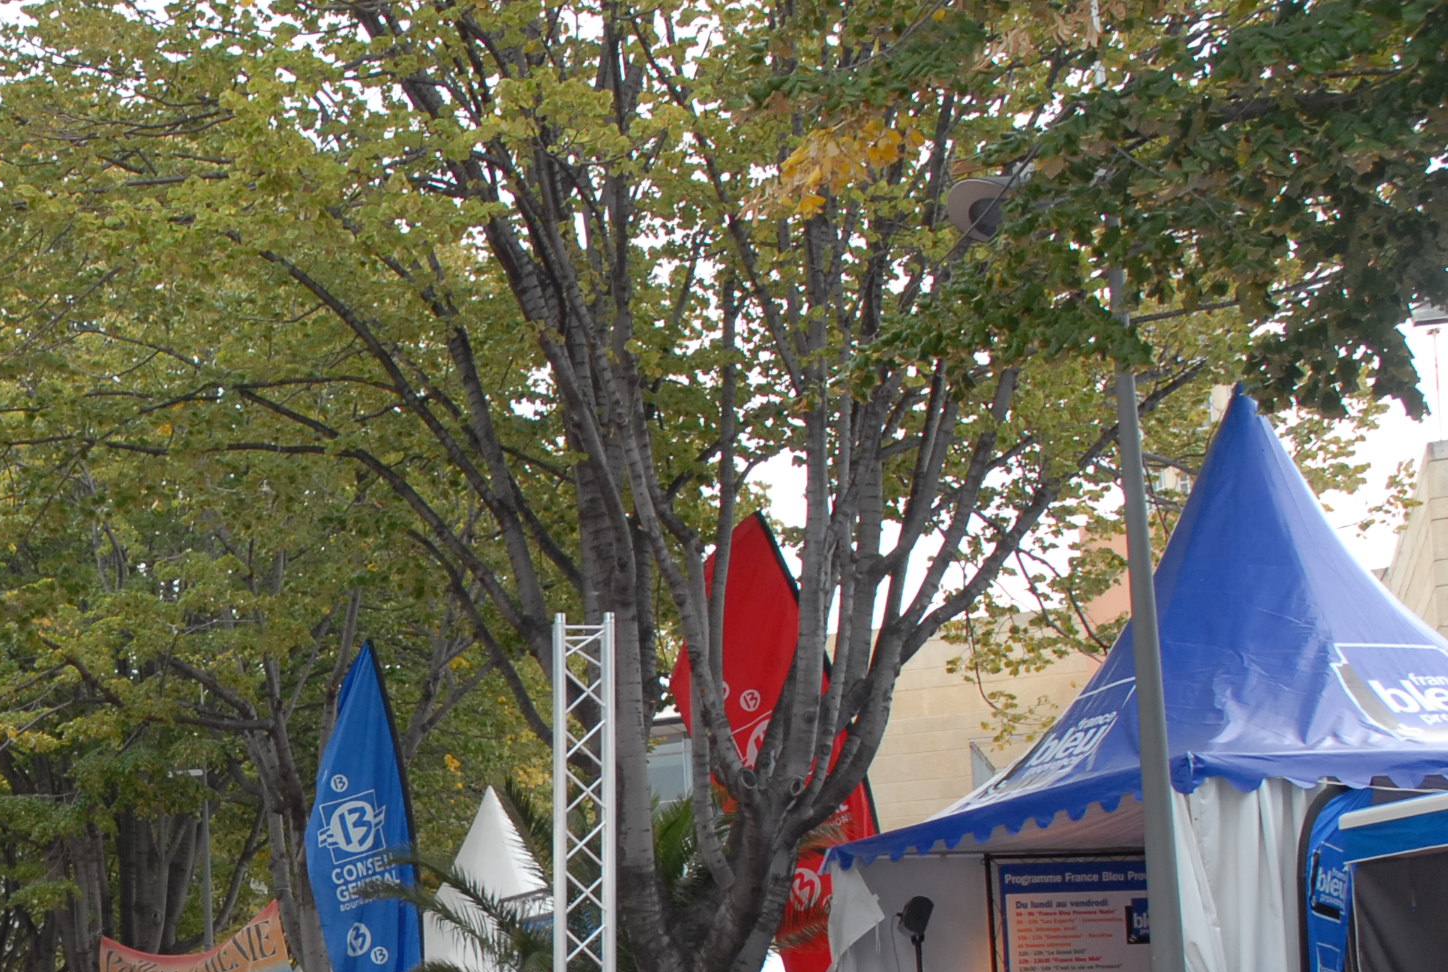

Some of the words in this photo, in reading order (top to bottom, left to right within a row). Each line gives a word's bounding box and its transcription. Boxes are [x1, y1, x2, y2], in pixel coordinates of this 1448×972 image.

[1368, 680, 1448, 713] ble
[1025, 725, 1108, 768] bleu
[333, 776, 346, 791] 13
[338, 805, 373, 847] 13
[1005, 873, 1062, 886] Programme
[1065, 872, 1099, 882] France
[1103, 871, 1124, 881] Bleu
[1016, 900, 1028, 909] Du
[1031, 899, 1052, 908] lundi
[1056, 900, 1067, 908] au
[1070, 898, 1108, 908] vendredi
[374, 948, 386, 962] 13
